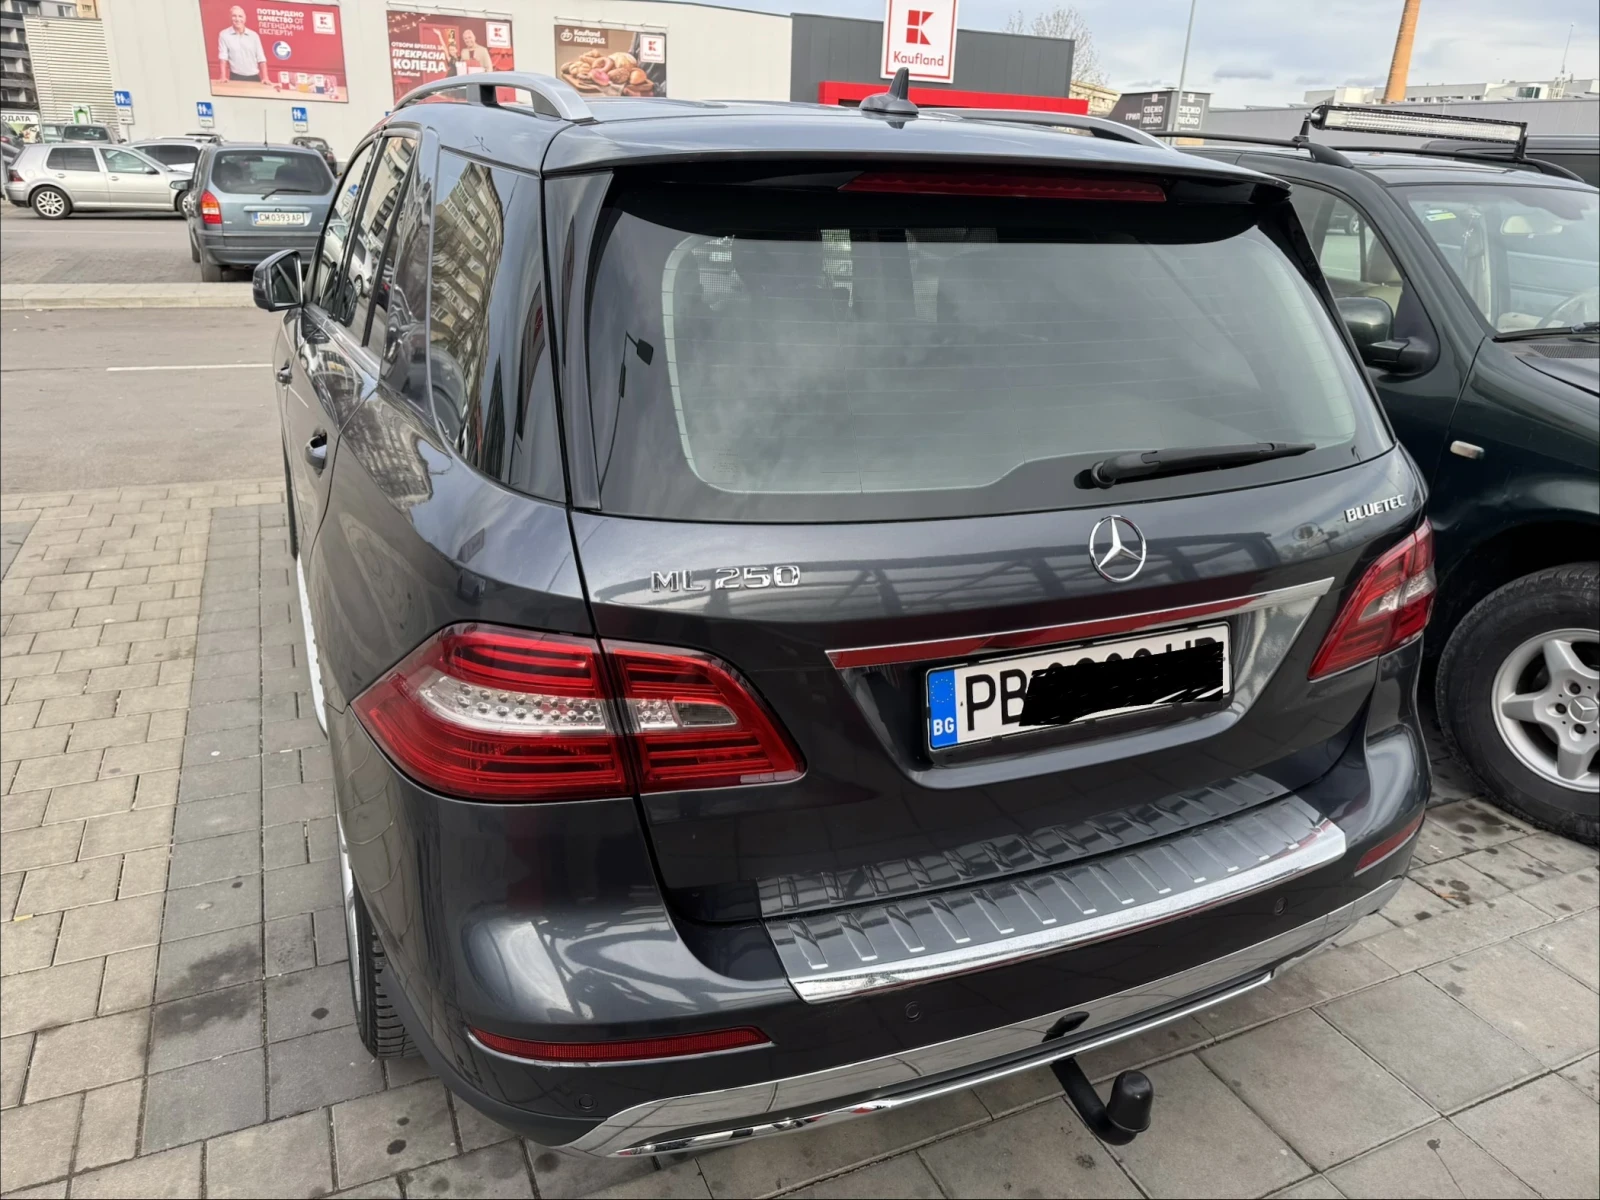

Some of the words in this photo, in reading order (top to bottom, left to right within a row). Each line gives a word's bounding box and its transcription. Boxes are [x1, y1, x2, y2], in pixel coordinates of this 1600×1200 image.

[256, 8, 304, 18] ПОТВЪРДЕНО
[257, 15, 293, 24] КАЧЕСТВО
[294, 17, 304, 25] ОТ
[258, 21, 304, 31] ЛЕГЕНДАРНИ
[259, 28, 293, 37] ЕКСПЕРТИ
[573, 28, 601, 38] Kaufland
[391, 41, 414, 49] ОТВОРИ
[392, 49, 446, 60] ПРЕКРАСНА
[893, 51, 944, 66] Kaufland
[393, 58, 447, 73] КОЛЕДА
[271, 213, 290, 222] 0393
[1344, 494, 1407, 523] BLUETEC
[650, 569, 706, 593] ML
[714, 564, 801, 591] 250
[932, 716, 956, 737] BG
